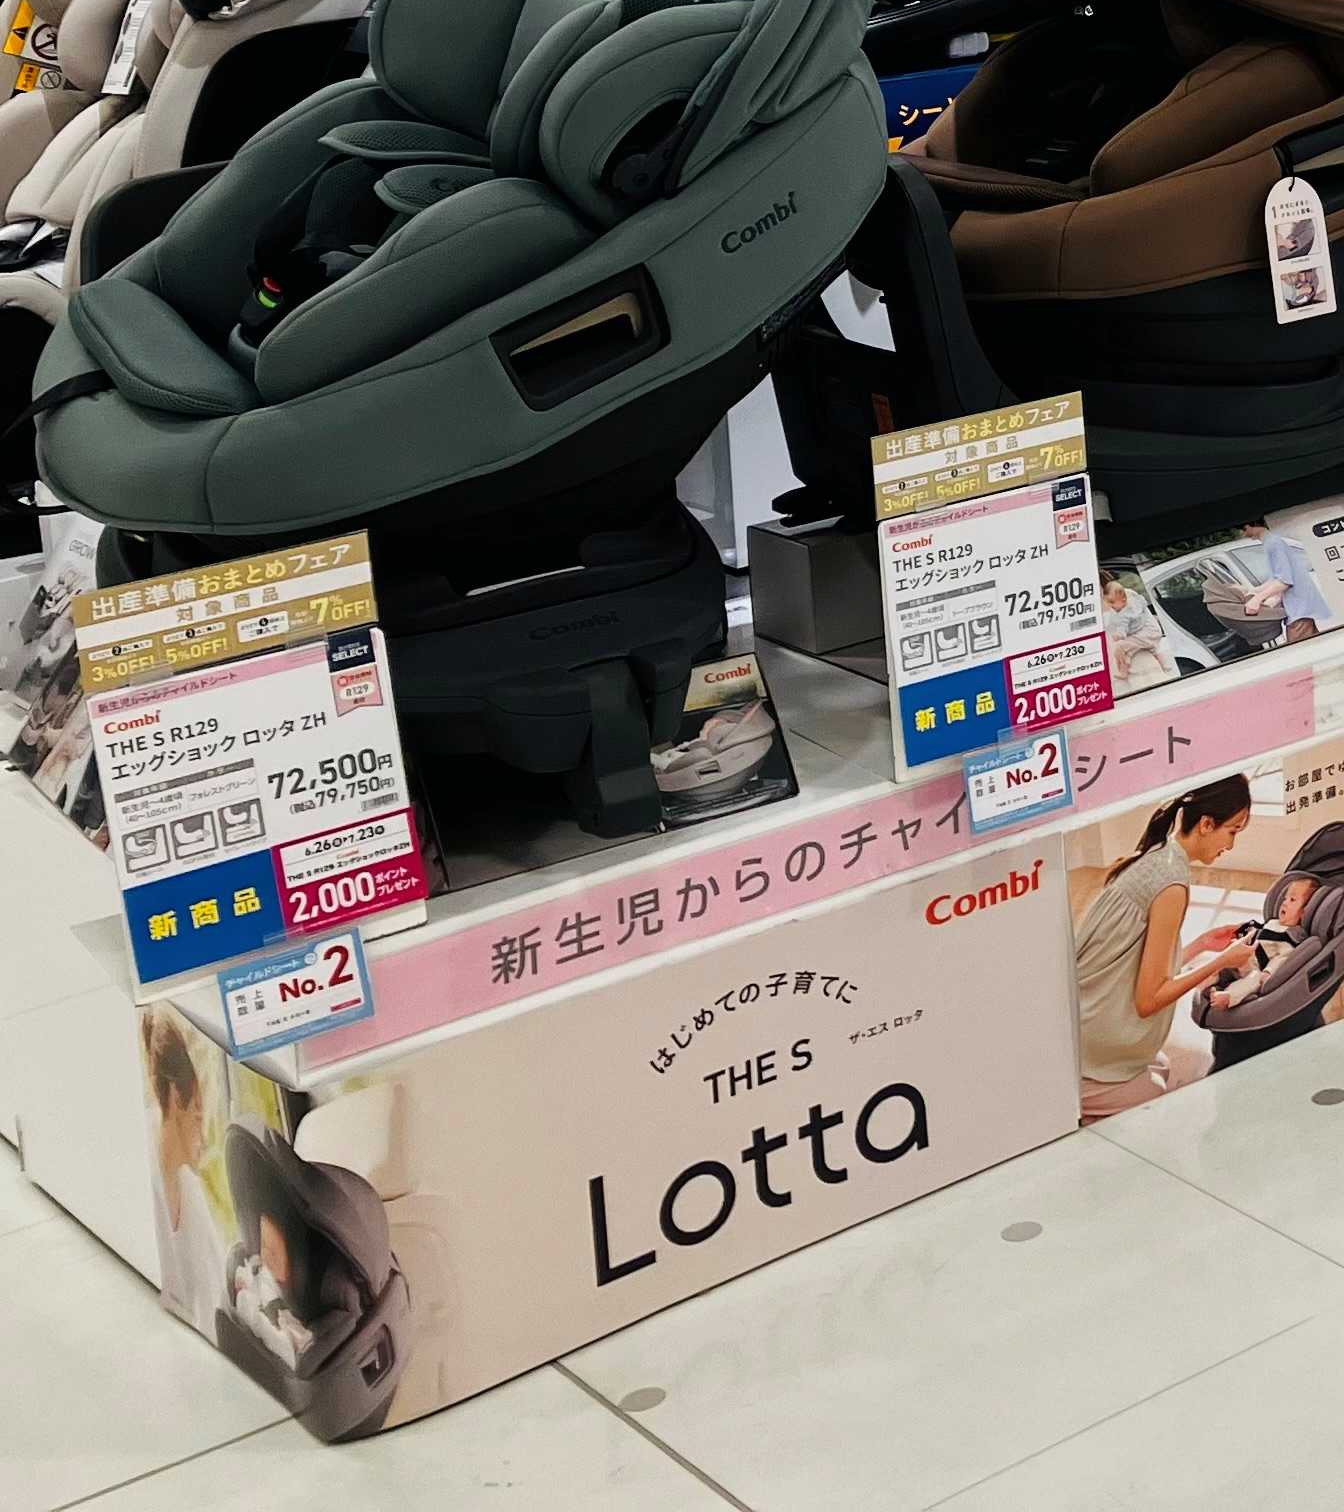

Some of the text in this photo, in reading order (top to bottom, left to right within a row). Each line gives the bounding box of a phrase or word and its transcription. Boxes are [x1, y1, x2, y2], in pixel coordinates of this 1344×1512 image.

[720, 191, 799, 254] Combi
[886, 401, 1070, 459] 出産準備おまとめフェア
[945, 436, 1018, 463] 対象商品
[1055, 490, 1082, 502] SELECT
[892, 534, 933, 553] Combi
[893, 544, 973, 573] THE S R129
[91, 543, 350, 621] 出産準備おまとめフェア
[896, 544, 1049, 593] エッグショック ロッタ ZH
[176, 587, 279, 622] 対象商品
[1005, 577, 1094, 616] 72,500円
[332, 645, 369, 662] SELECT
[704, 664, 751, 684] Combi
[1077, 682, 1100, 695] ポイント
[915, 691, 996, 732] 新商品
[1015, 684, 1076, 724] 2,000
[1078, 691, 1108, 705] プレゼント
[104, 710, 161, 735] Combi
[106, 718, 219, 758] THE S R129
[111, 712, 327, 780] エッグショック ロッタ ZH
[268, 748, 393, 800] 72,500円
[1286, 787, 1344, 815] 出発準備。
[375, 867, 408, 884] ポイント
[491, 726, 1194, 985] 新生児からのチャイシート
[289, 871, 376, 923] 2,000
[377, 877, 419, 897] プレゼント
[924, 859, 1044, 926] Combi
[149, 887, 262, 941] 新商品
[650, 970, 859, 1075] はじめての子育てに
[703, 1008, 923, 1104] THE S ロッタ
[588, 1082, 930, 1288] Lotta
